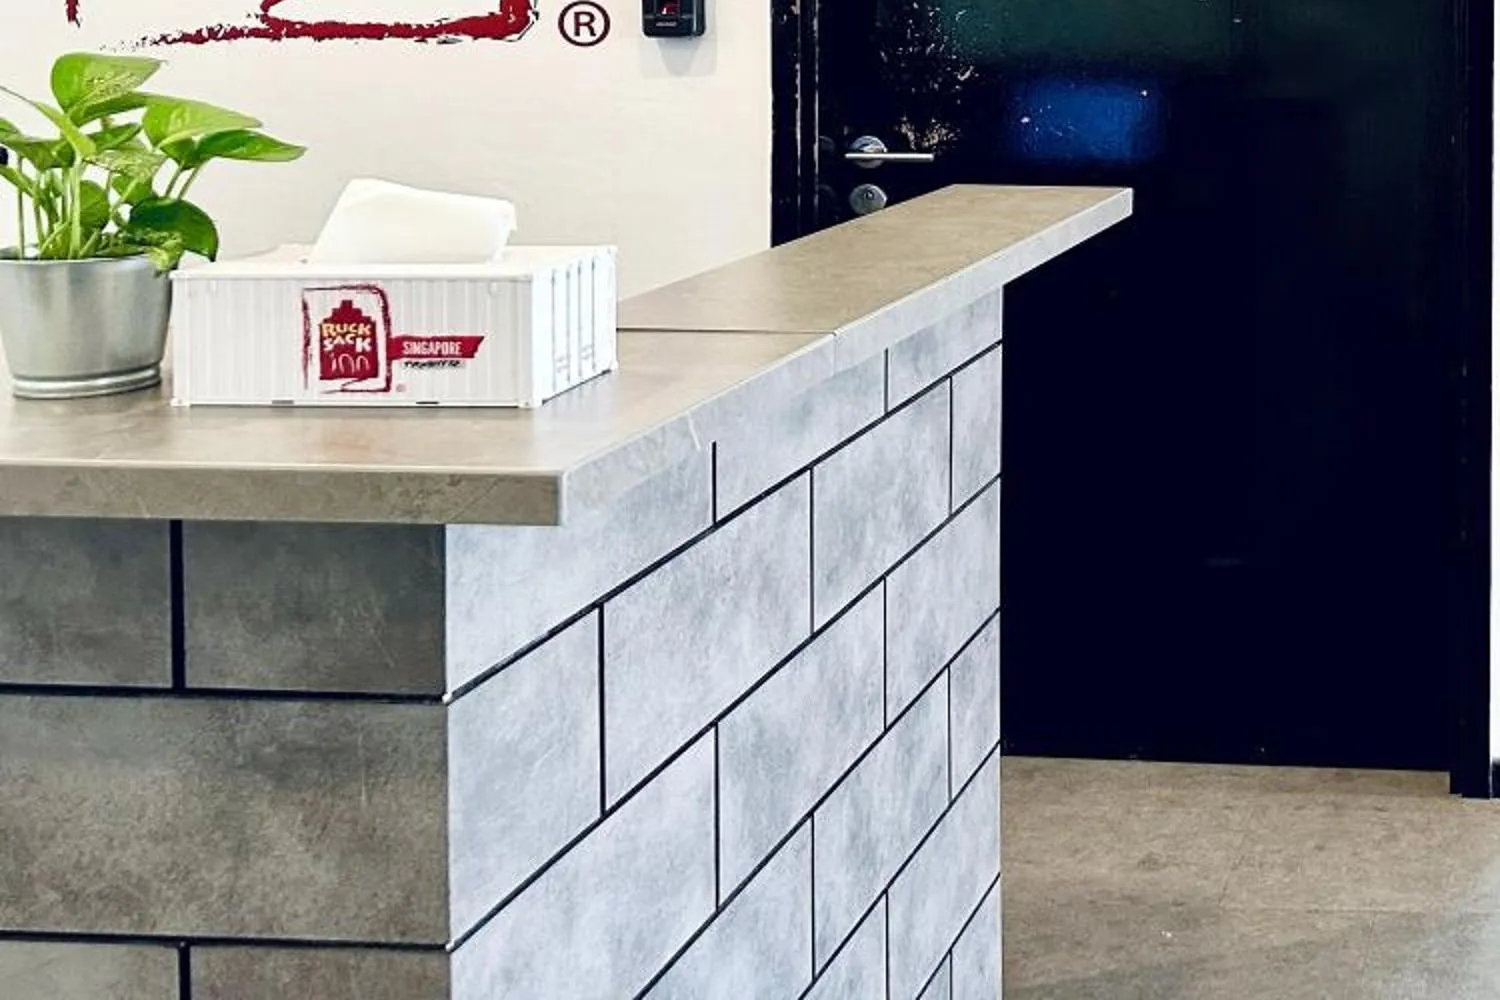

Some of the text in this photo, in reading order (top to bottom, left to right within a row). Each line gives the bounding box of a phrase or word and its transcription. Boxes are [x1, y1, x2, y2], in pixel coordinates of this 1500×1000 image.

[321, 323, 372, 337] RUCK
[322, 333, 372, 353] SACK
[402, 341, 463, 356] SINGAPORE
